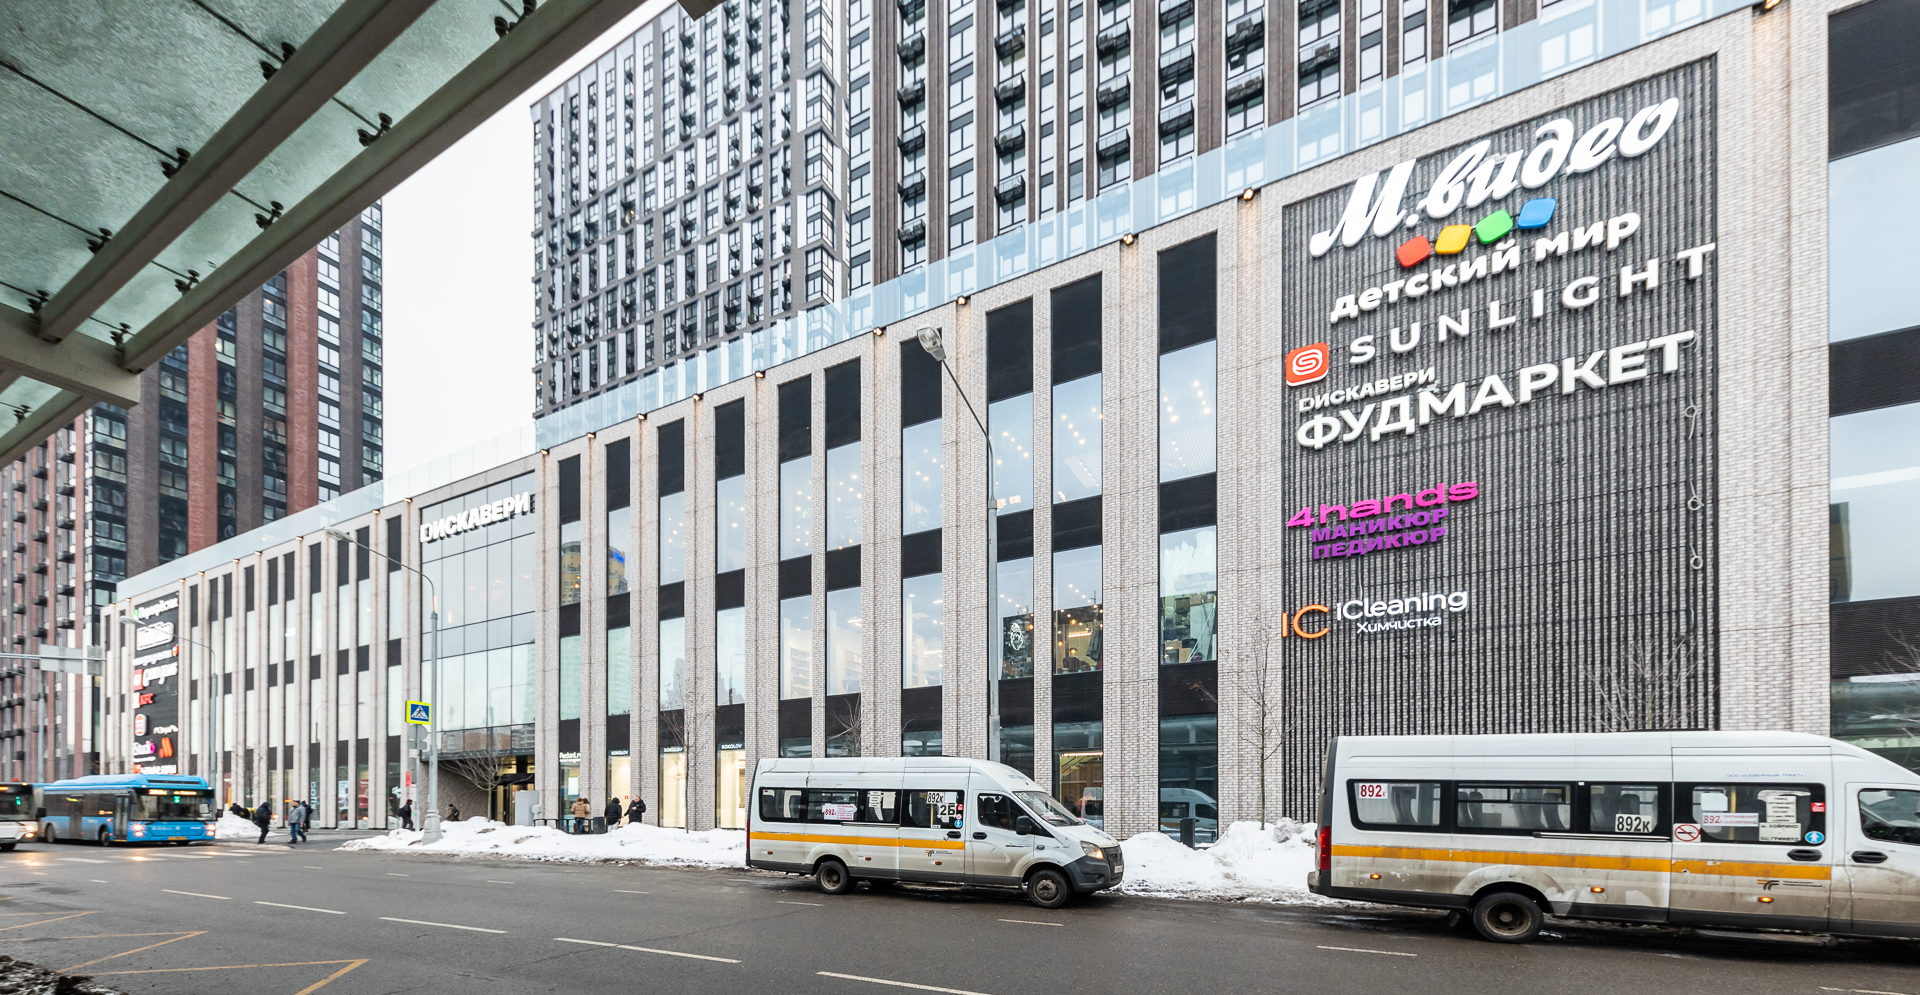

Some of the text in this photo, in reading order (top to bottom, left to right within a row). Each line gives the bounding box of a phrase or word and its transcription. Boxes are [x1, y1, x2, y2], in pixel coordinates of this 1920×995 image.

[1310, 98, 1679, 257] М.видео
[1330, 212, 1641, 323] детский мир
[1350, 243, 1715, 364] SUNLIGHT
[1297, 330, 1695, 449] ФУДМАРКЕТ
[1287, 482, 1479, 527] 4hands
[1312, 508, 1448, 543] МАНИКЮР
[1314, 527, 1446, 560] ПЕДИКЮР
[1336, 591, 1468, 621] iCleaning
[1357, 616, 1442, 634] Химчистка
[940, 805, 956, 815] 2Б
